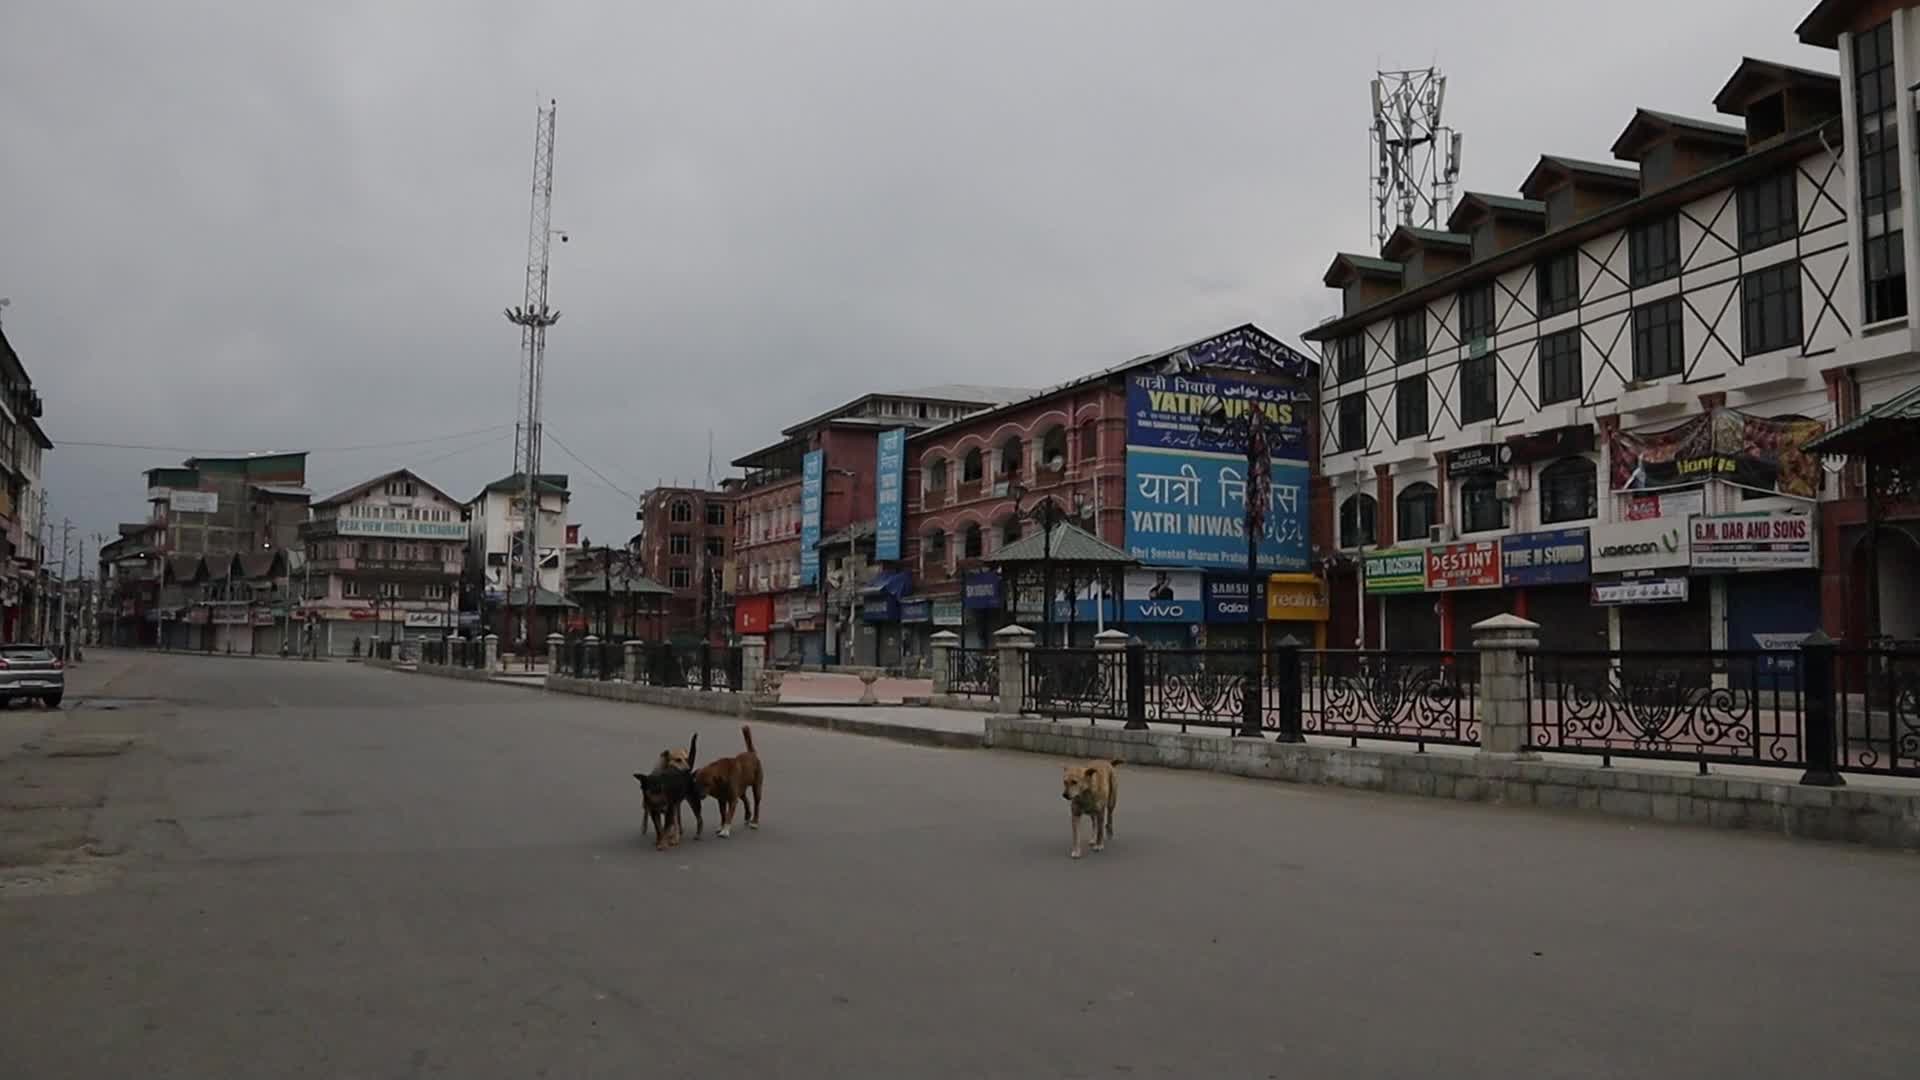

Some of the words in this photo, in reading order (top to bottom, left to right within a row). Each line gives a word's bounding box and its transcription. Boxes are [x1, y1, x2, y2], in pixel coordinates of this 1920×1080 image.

[1149, 390, 1202, 415] YATR
[1136, 463, 1201, 506] यात्री
[1131, 511, 1181, 534] YATRI
[1187, 514, 1244, 538] NIWAS
[1695, 522, 1719, 540] G.M.
[1722, 522, 1744, 540] DAR
[1746, 521, 1770, 539] AND
[1773, 520, 1806, 538] SONS
[1431, 550, 1493, 571] DESTINY
[1211, 583, 1264, 595] SAMSUG
[1139, 601, 1184, 617] vivo
[1217, 601, 1250, 614] Galax
